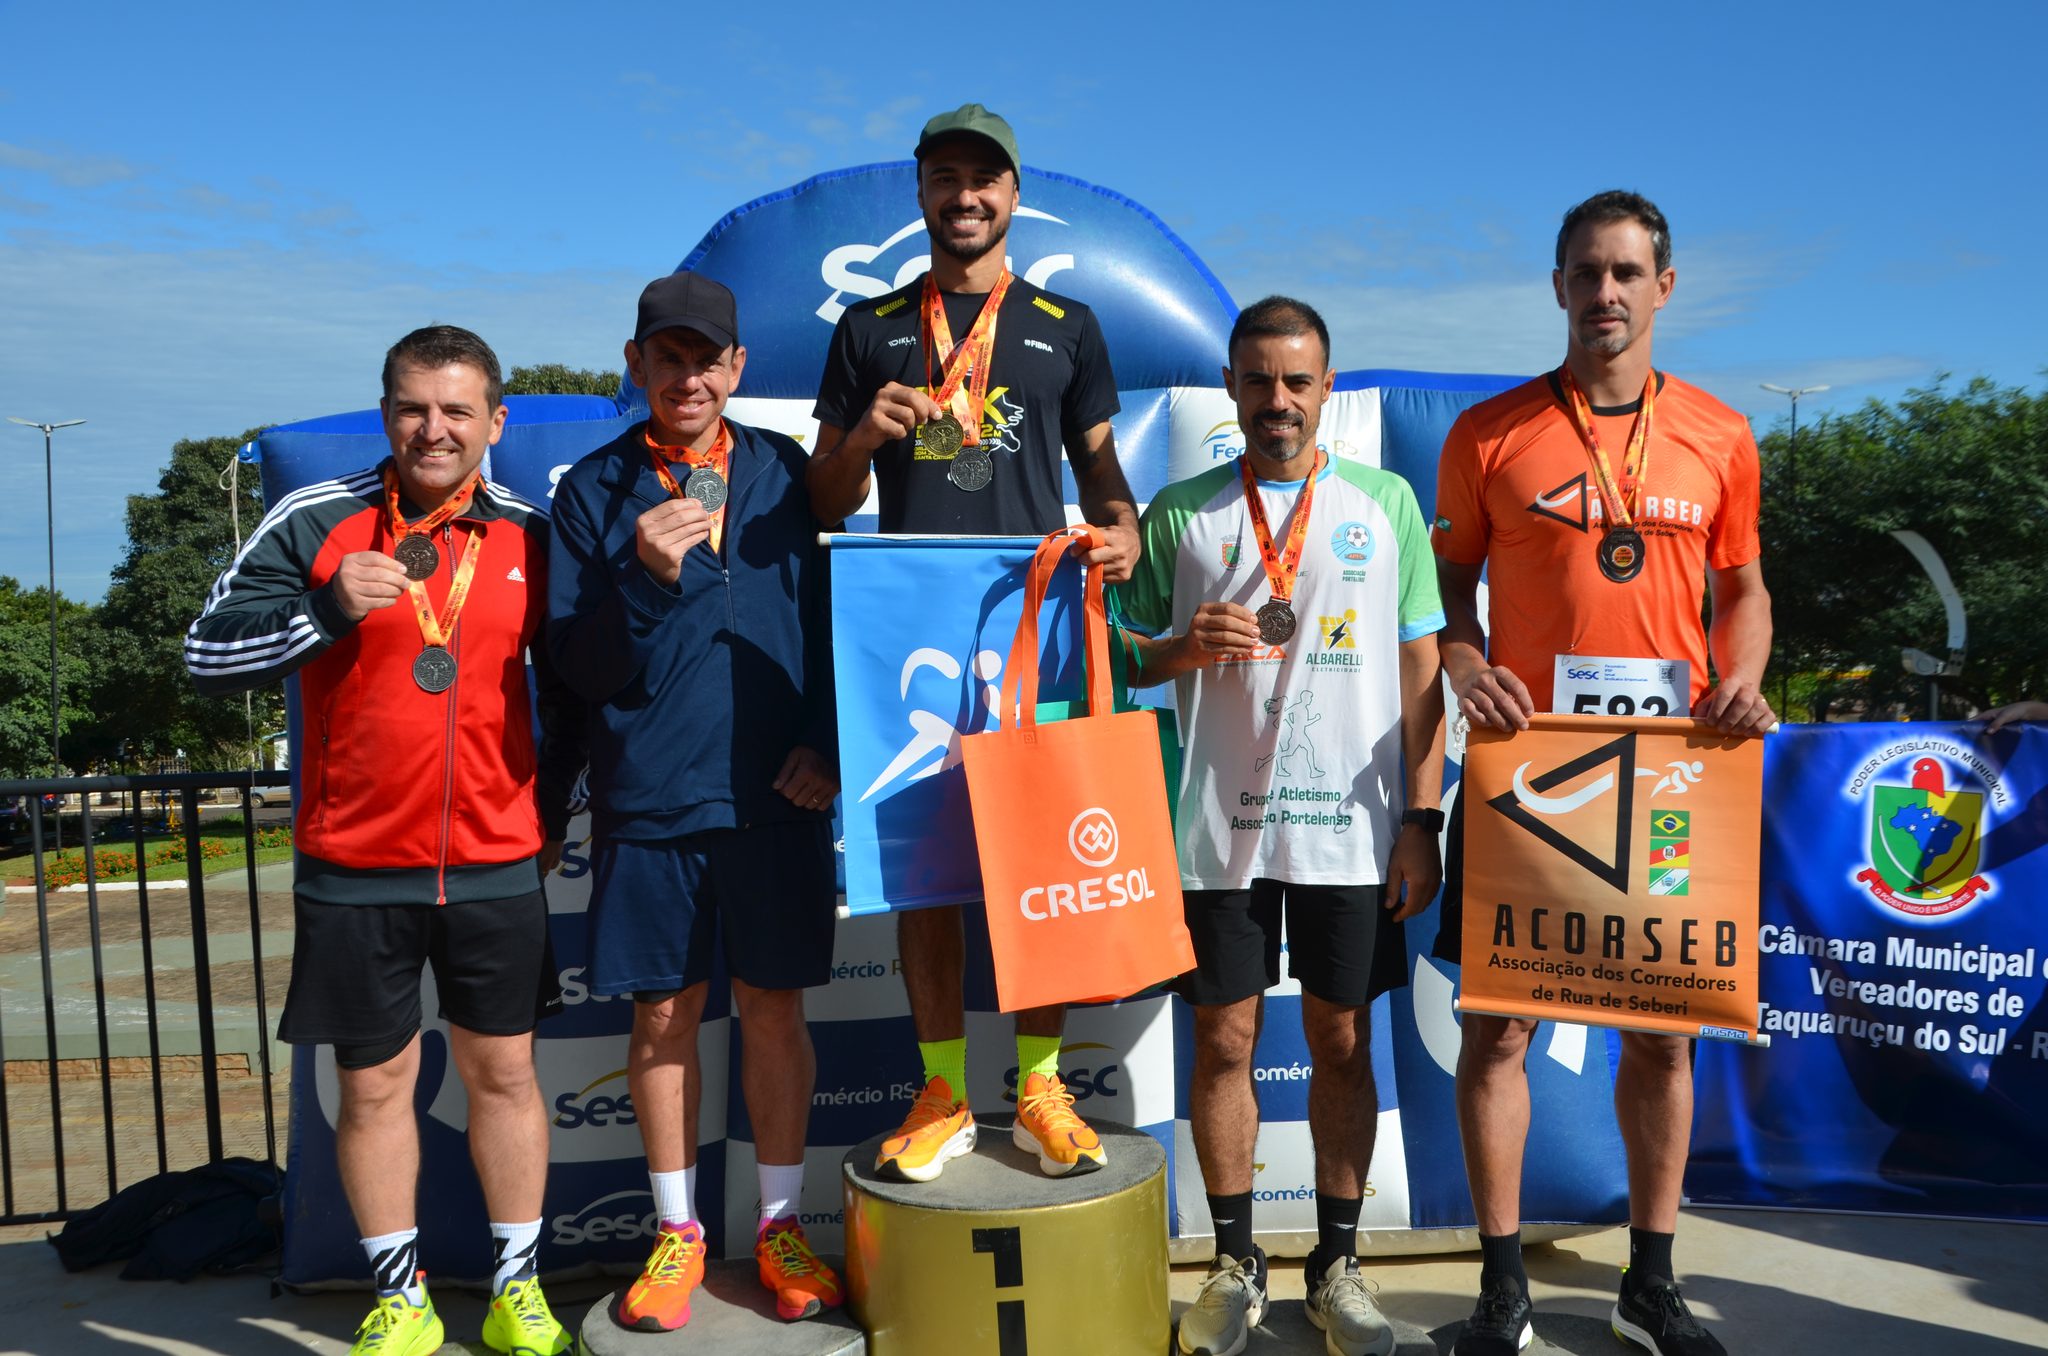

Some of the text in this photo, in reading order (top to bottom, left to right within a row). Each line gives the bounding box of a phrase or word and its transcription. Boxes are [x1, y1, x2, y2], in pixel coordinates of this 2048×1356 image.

[1590, 496, 1702, 525] ARSEB
[1278, 786, 1341, 802] Atletismo
[1850, 741, 2007, 806] PODER LEGISLATIVO MUNICIPAL
[1281, 810, 1353, 826] Portelense
[1019, 866, 1156, 921] CRESOL
[1492, 904, 1737, 967] ACORSEB
[1758, 924, 1877, 964] Câmara
[1886, 937, 2035, 982] Municipal
[1488, 953, 1737, 993] Associação dos Corredores
[1810, 967, 2025, 1018] Vereadores de
[1531, 984, 1689, 1016] de Rua de Seberi
[1757, 1002, 1905, 1048] Taquaruçu
[1914, 1022, 1951, 1052] do
[1958, 1024, 2007, 1056] Sul
[2031, 1031, 2048, 1060] R
[552, 1092, 638, 1130] Ses
